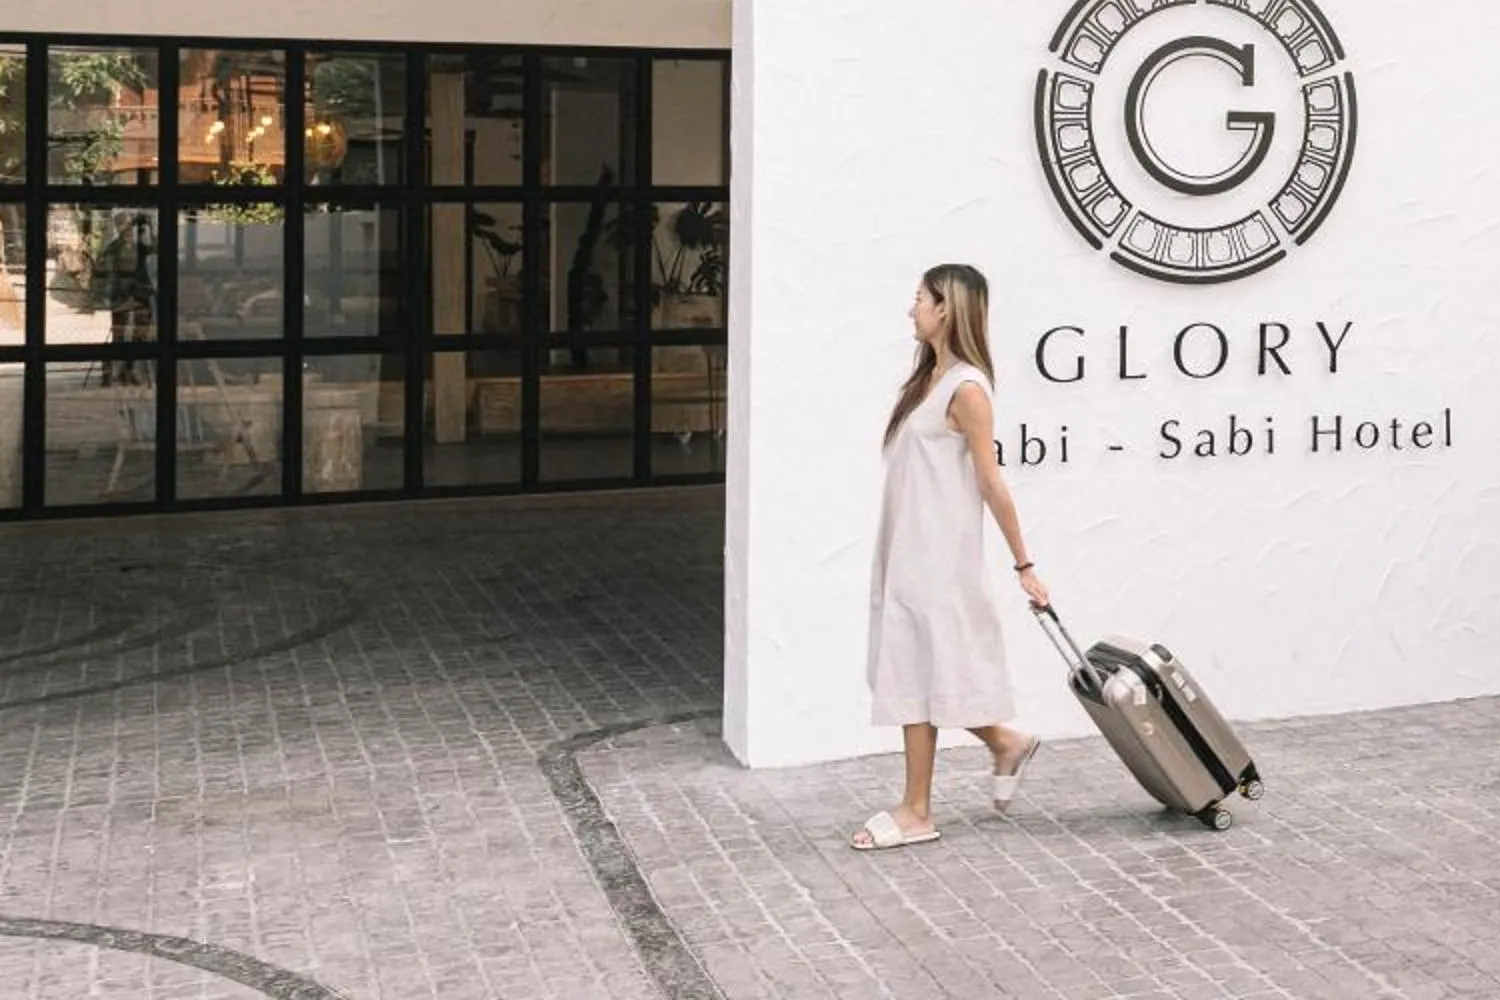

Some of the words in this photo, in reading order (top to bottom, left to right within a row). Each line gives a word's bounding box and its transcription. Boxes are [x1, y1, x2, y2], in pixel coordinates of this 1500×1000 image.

[1124, 35, 1275, 196] G
[1035, 321, 1353, 382] GLORY
[992, 423, 1068, 467] abi
[1159, 414, 1275, 459] Sabi
[1311, 407, 1452, 453] Hotel
